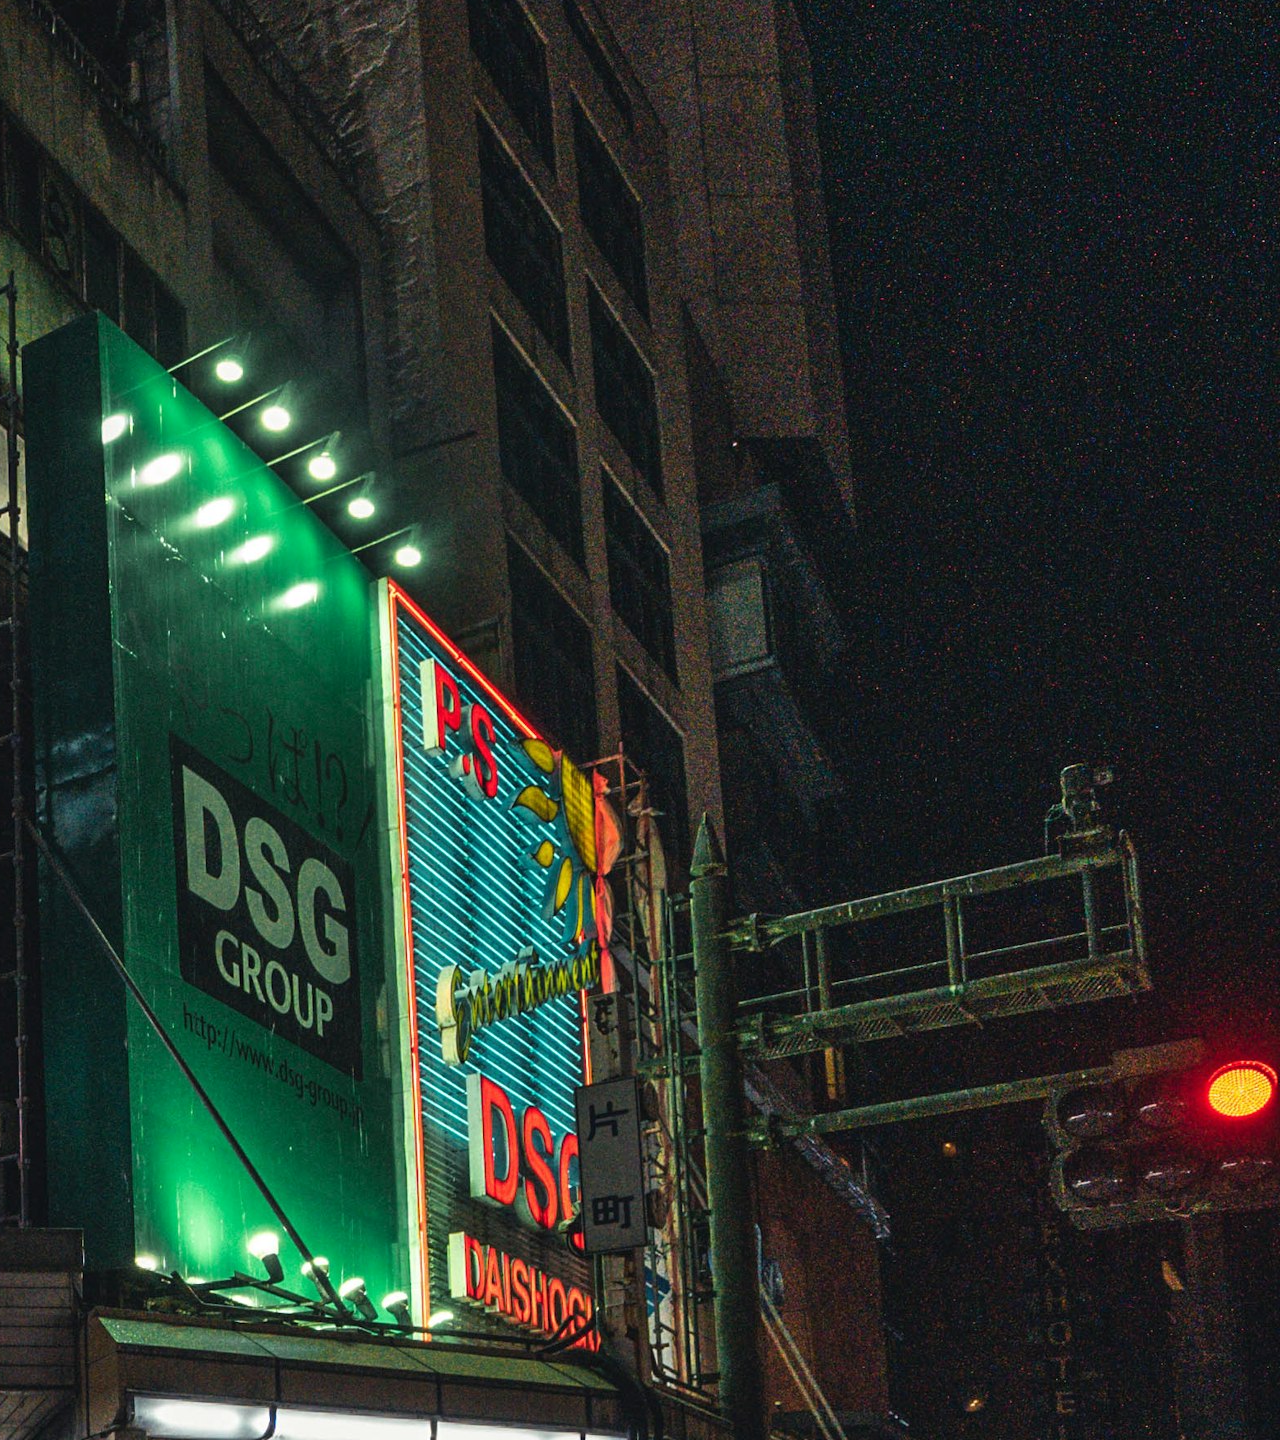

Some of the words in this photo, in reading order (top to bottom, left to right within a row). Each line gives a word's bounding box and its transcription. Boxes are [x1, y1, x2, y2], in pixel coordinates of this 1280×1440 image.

[181, 764, 353, 986] DSG
[214, 933, 334, 1038] GROUP
[443, 948, 600, 1065] Entertainment
[587, 1100, 636, 1229] 片町
